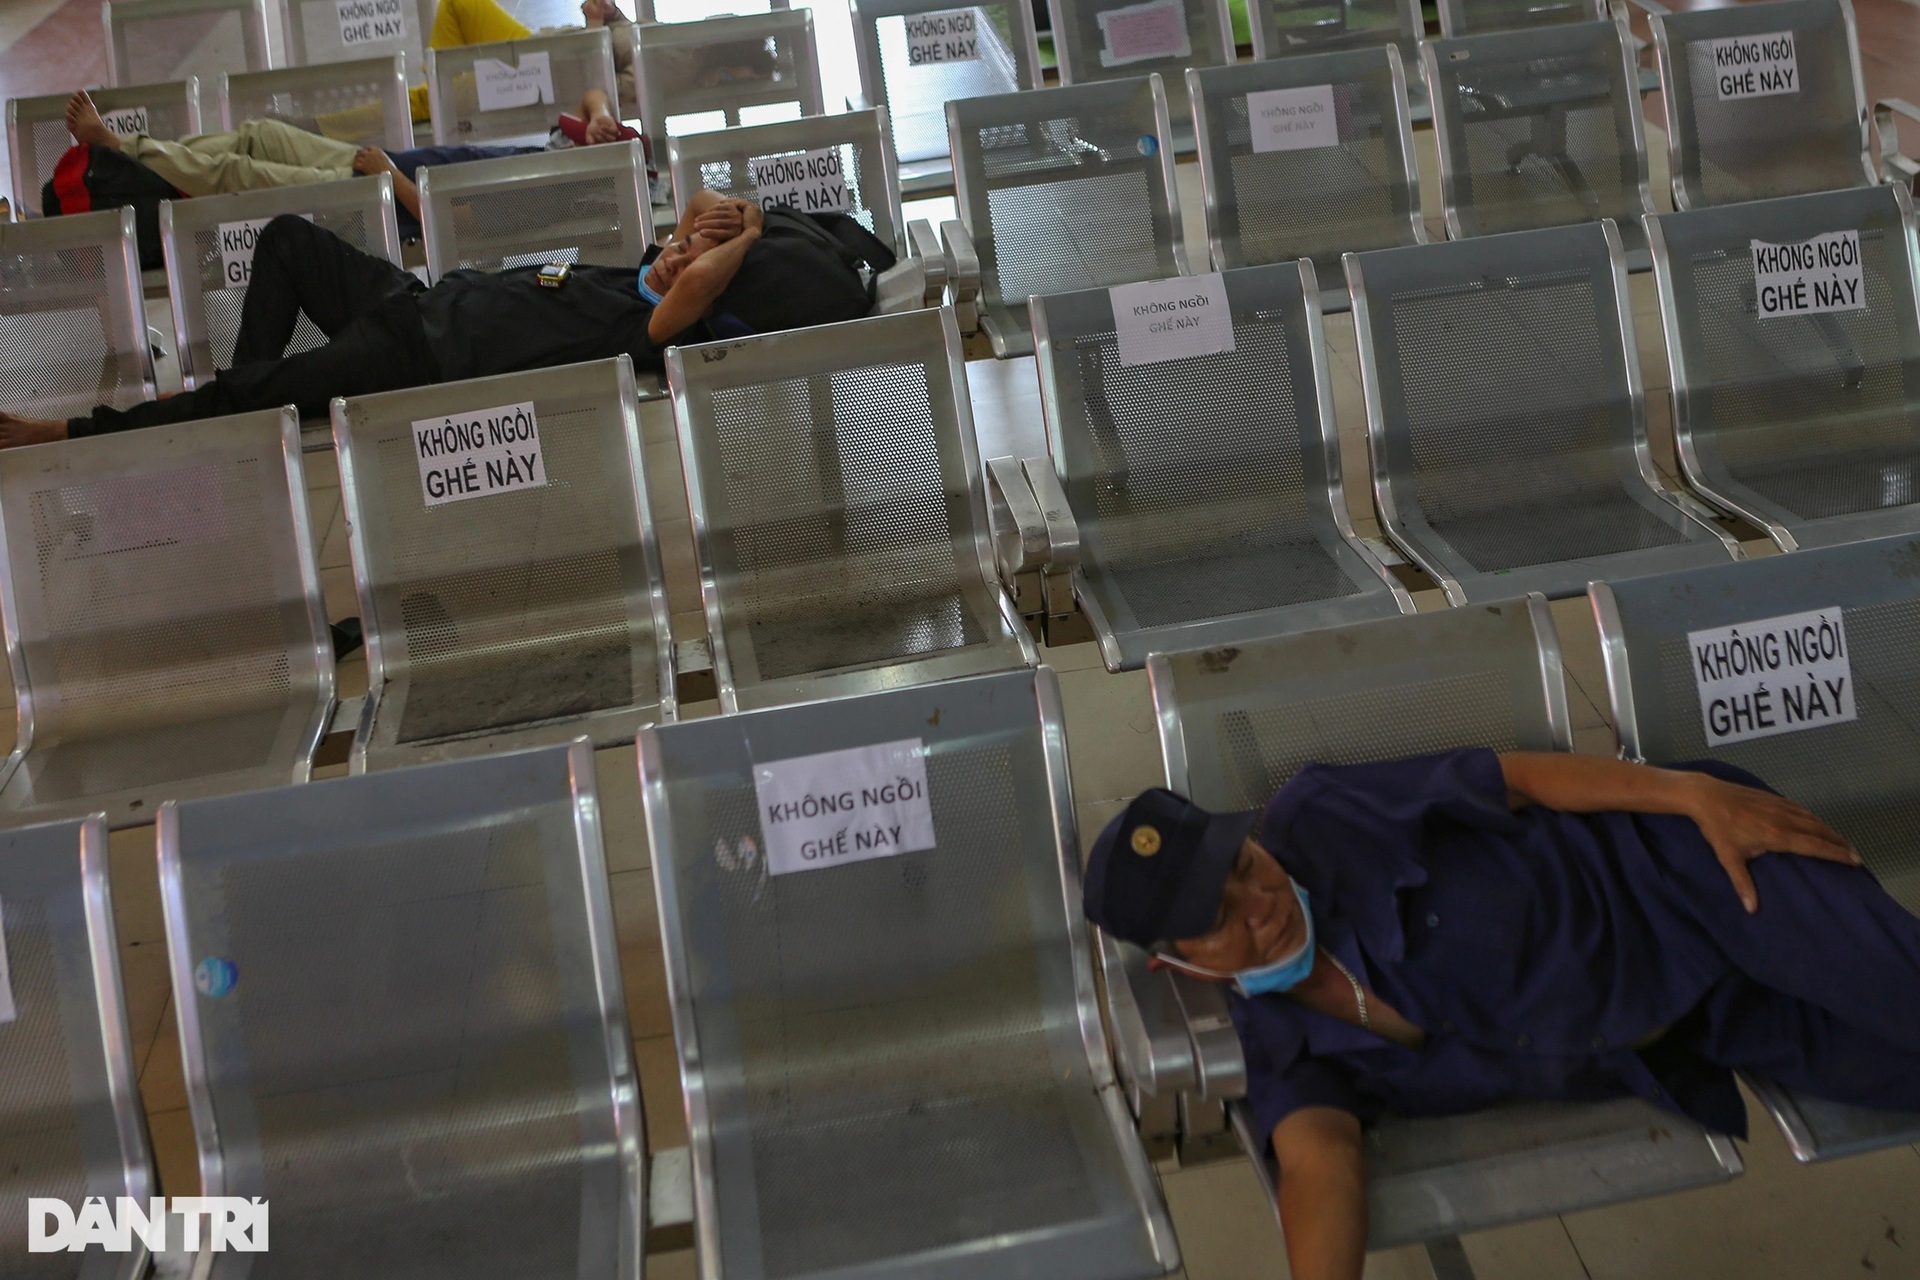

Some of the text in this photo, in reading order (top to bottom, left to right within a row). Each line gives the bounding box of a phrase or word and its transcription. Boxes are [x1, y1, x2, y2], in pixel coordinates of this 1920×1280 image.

[945, 36, 976, 59] NÀY
[1715, 39, 1760, 67] KHÔNG
[1760, 64, 1793, 91] NÀY
[756, 158, 805, 187] KHÔNG
[805, 182, 842, 210] NÀY
[228, 260, 252, 282] GH
[1133, 294, 1210, 316] KHÔNG NGỒI
[1761, 273, 1858, 312] GHẾ NÀY
[1149, 316, 1200, 333] GHẾ NÀY
[417, 407, 535, 458] KHÔNG NGỒI
[426, 449, 537, 498] GHẾ NÀY
[1697, 614, 1844, 682] KHÔNG NGỒI
[1709, 672, 1845, 737] GHẾ NÀY
[769, 776, 922, 824] KHÔNG NGỒI
[801, 823, 902, 860] GHẾ NÀY
